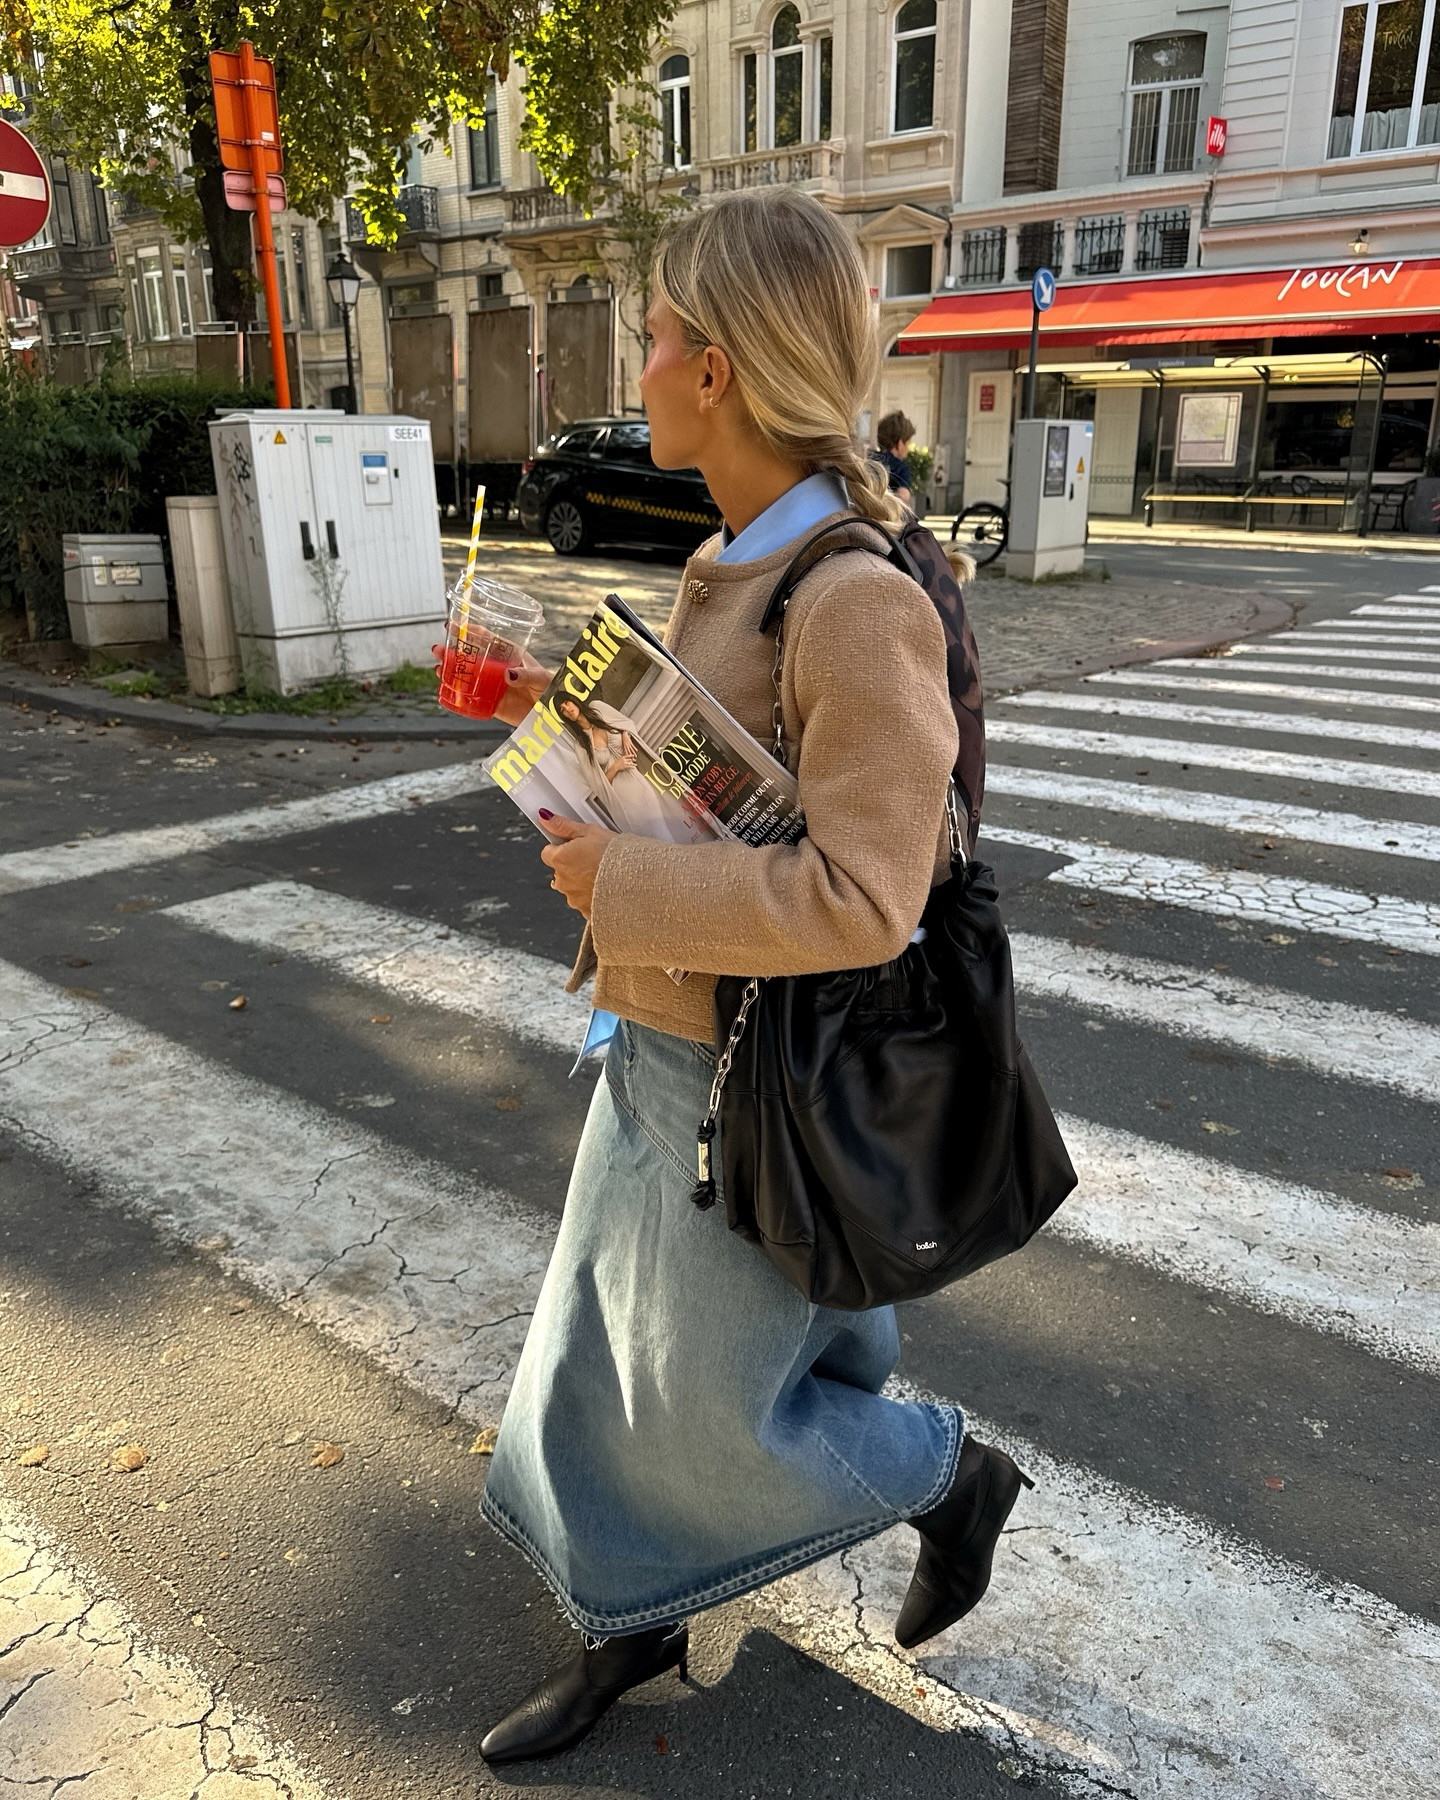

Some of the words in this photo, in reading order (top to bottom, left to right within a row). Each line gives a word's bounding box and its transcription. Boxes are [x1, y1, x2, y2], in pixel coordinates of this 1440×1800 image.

[1209, 123, 1226, 153] illy
[394, 427, 423, 440] SEE41
[564, 610, 631, 702] claire
[644, 720, 707, 796] ICÔNE
[680, 750, 712, 785] MODE
[713, 764, 739, 793] BELGE
[736, 793, 759, 816] COMME
[754, 775, 774, 796] OUTIL
[727, 805, 760, 838] NCIPATION
[739, 810, 769, 842] ARFUMERIE
[766, 793, 786, 813] SELON
[750, 813, 779, 843] WILLIAMS
[765, 816, 791, 844] L'ALLURE
[787, 818, 805, 836] POUR
